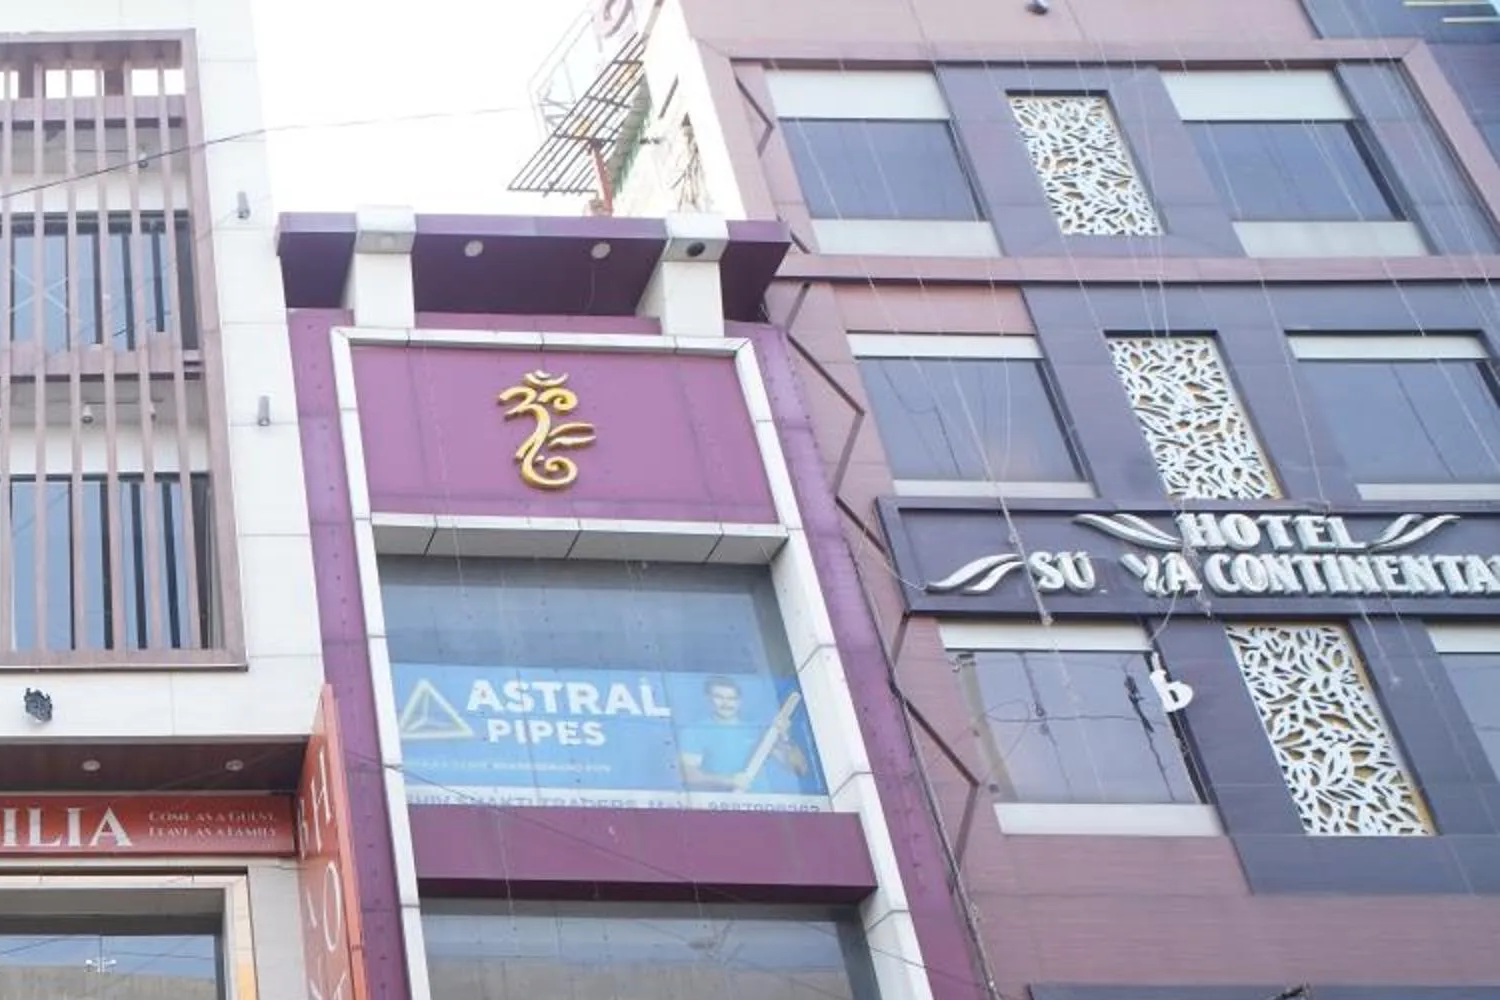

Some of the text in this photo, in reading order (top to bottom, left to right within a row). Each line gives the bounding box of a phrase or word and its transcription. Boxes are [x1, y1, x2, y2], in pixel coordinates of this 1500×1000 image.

[1176, 513, 1368, 551] HOTEL
[467, 677, 671, 717] ASTRAL
[487, 719, 607, 747] PIPES
